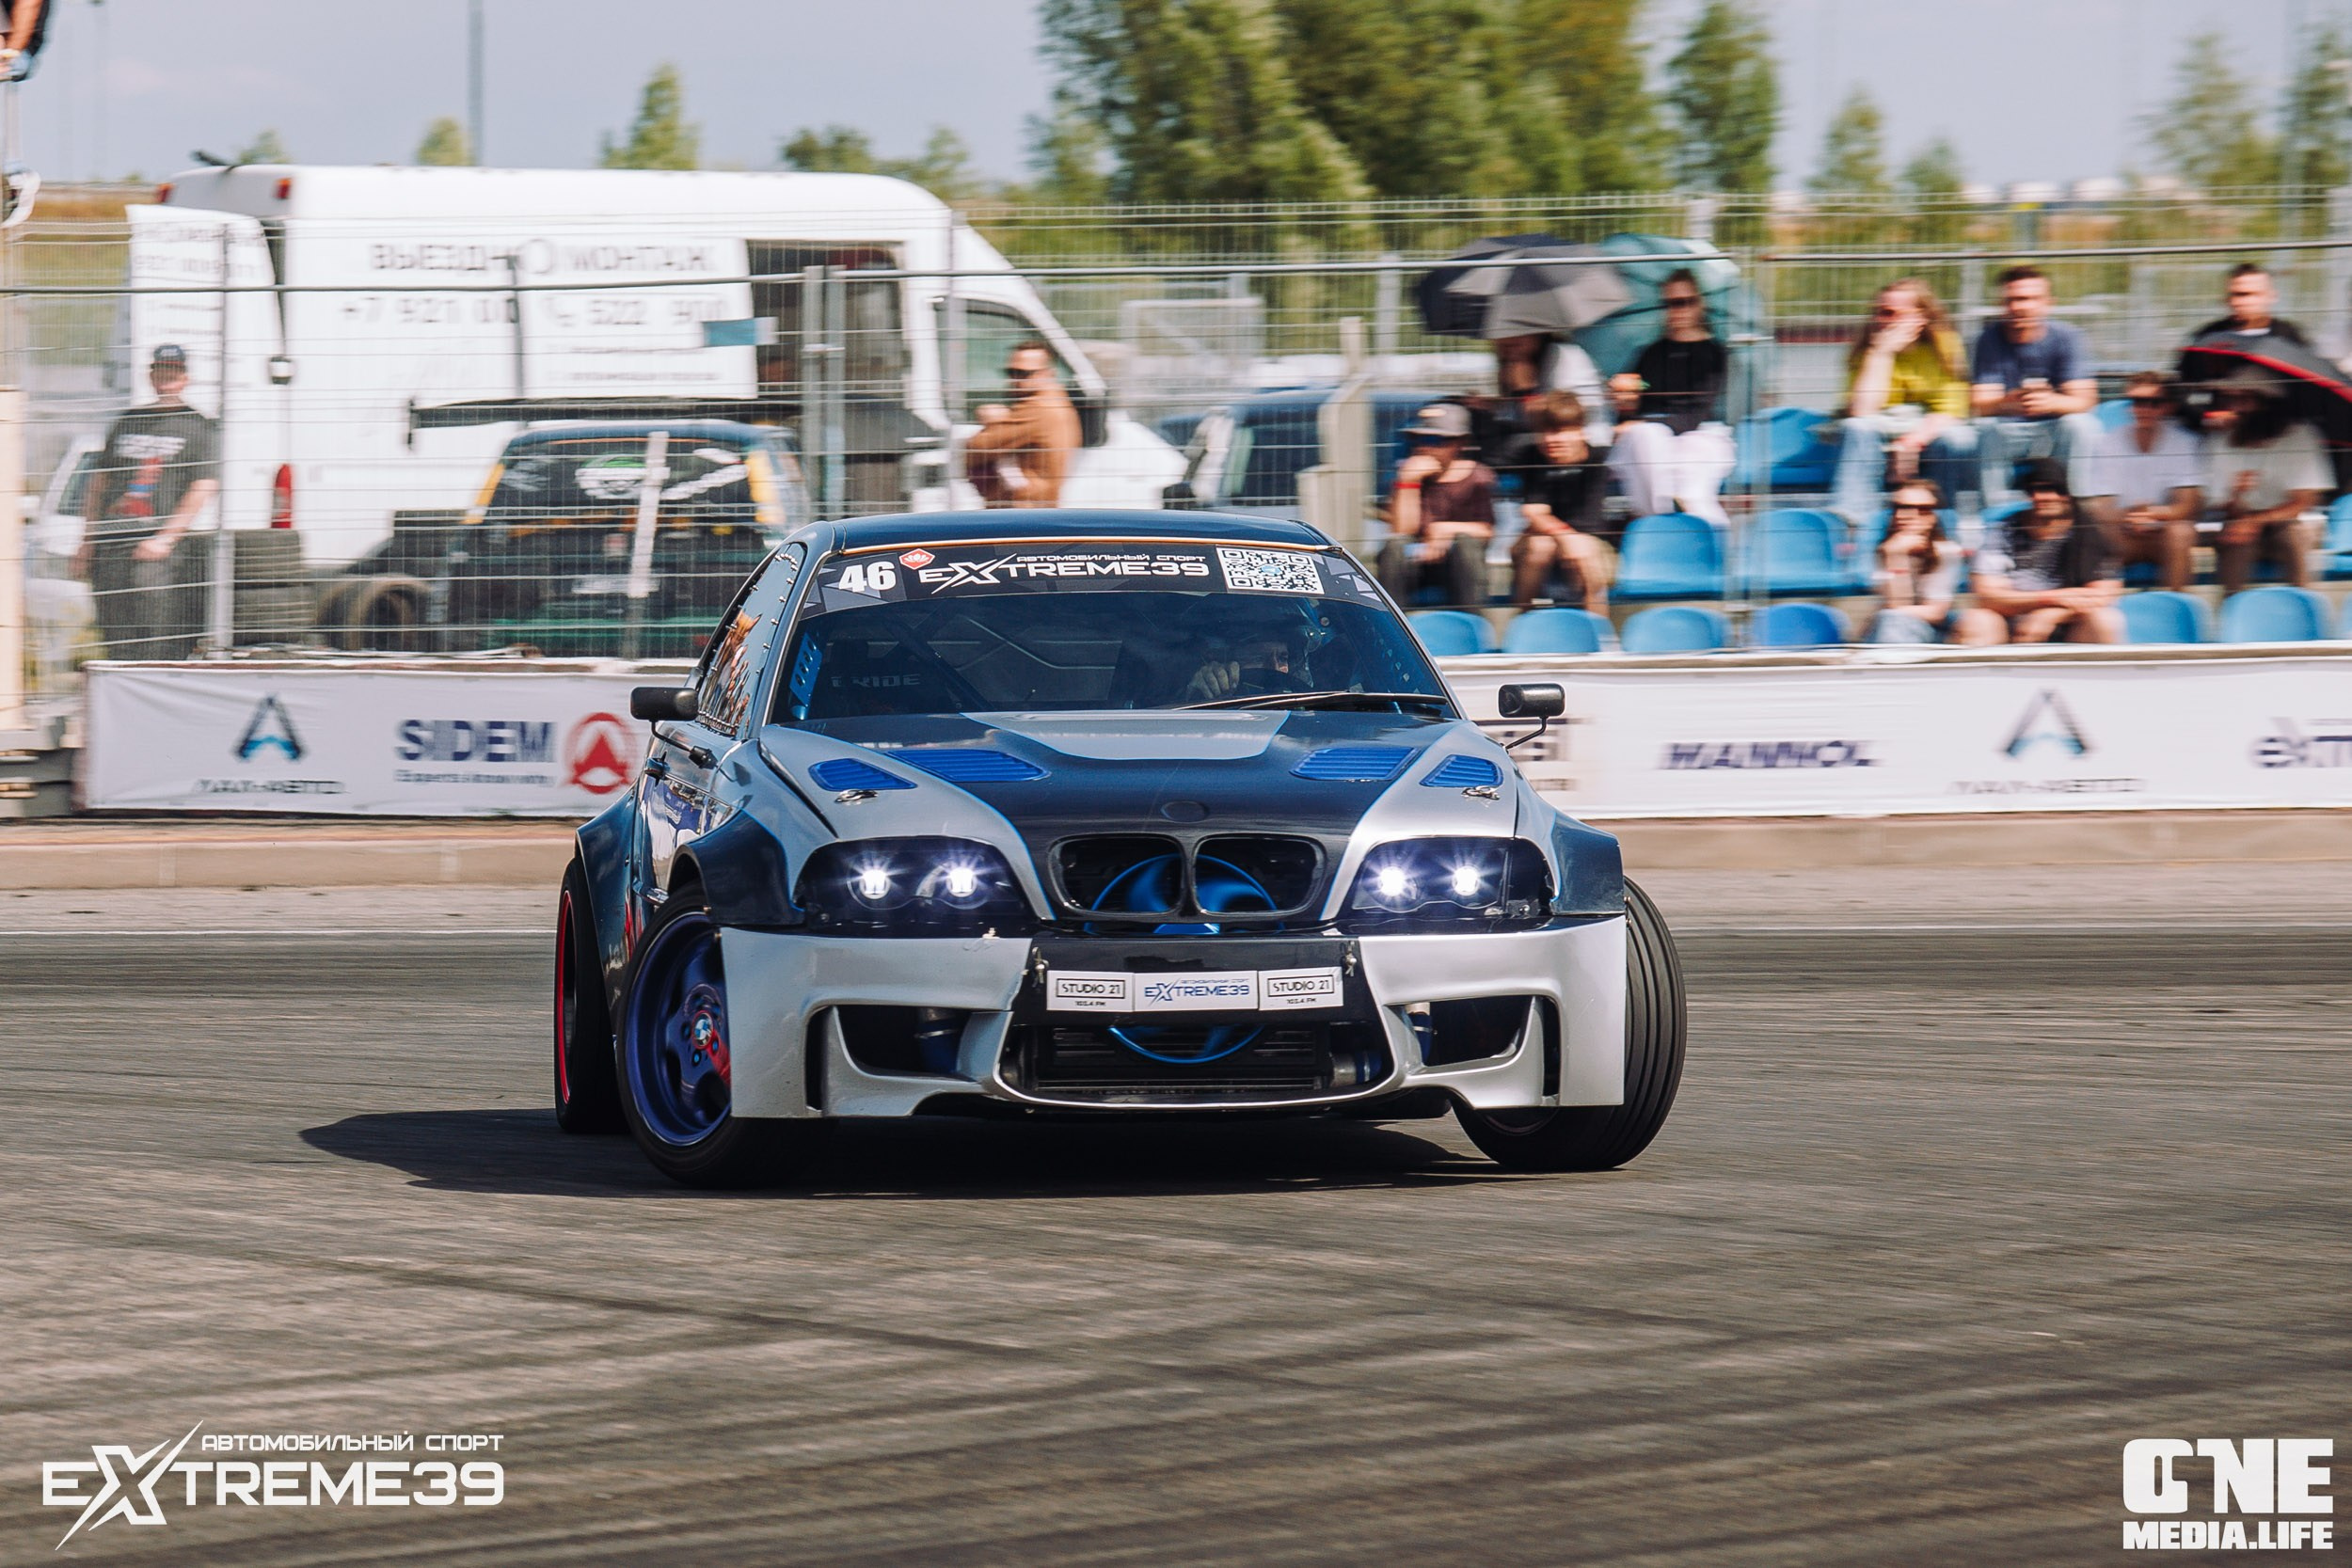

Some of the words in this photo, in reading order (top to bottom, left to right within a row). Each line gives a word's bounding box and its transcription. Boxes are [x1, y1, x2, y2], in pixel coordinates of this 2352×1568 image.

[1016, 553, 1150, 562] АВТОМОБИЛЬНЫЙ
[1156, 554, 1206, 562] СПОРТ
[838, 561, 897, 593] 46
[918, 553, 1210, 594] EXTREME39
[395, 720, 558, 763] SIDEM
[1062, 983, 1105, 994] STUDIO
[1109, 984, 1120, 994] 21
[1144, 978, 1249, 1006] EXTREME39
[1273, 981, 1315, 992] STUDIO
[1319, 979, 1329, 990] 21
